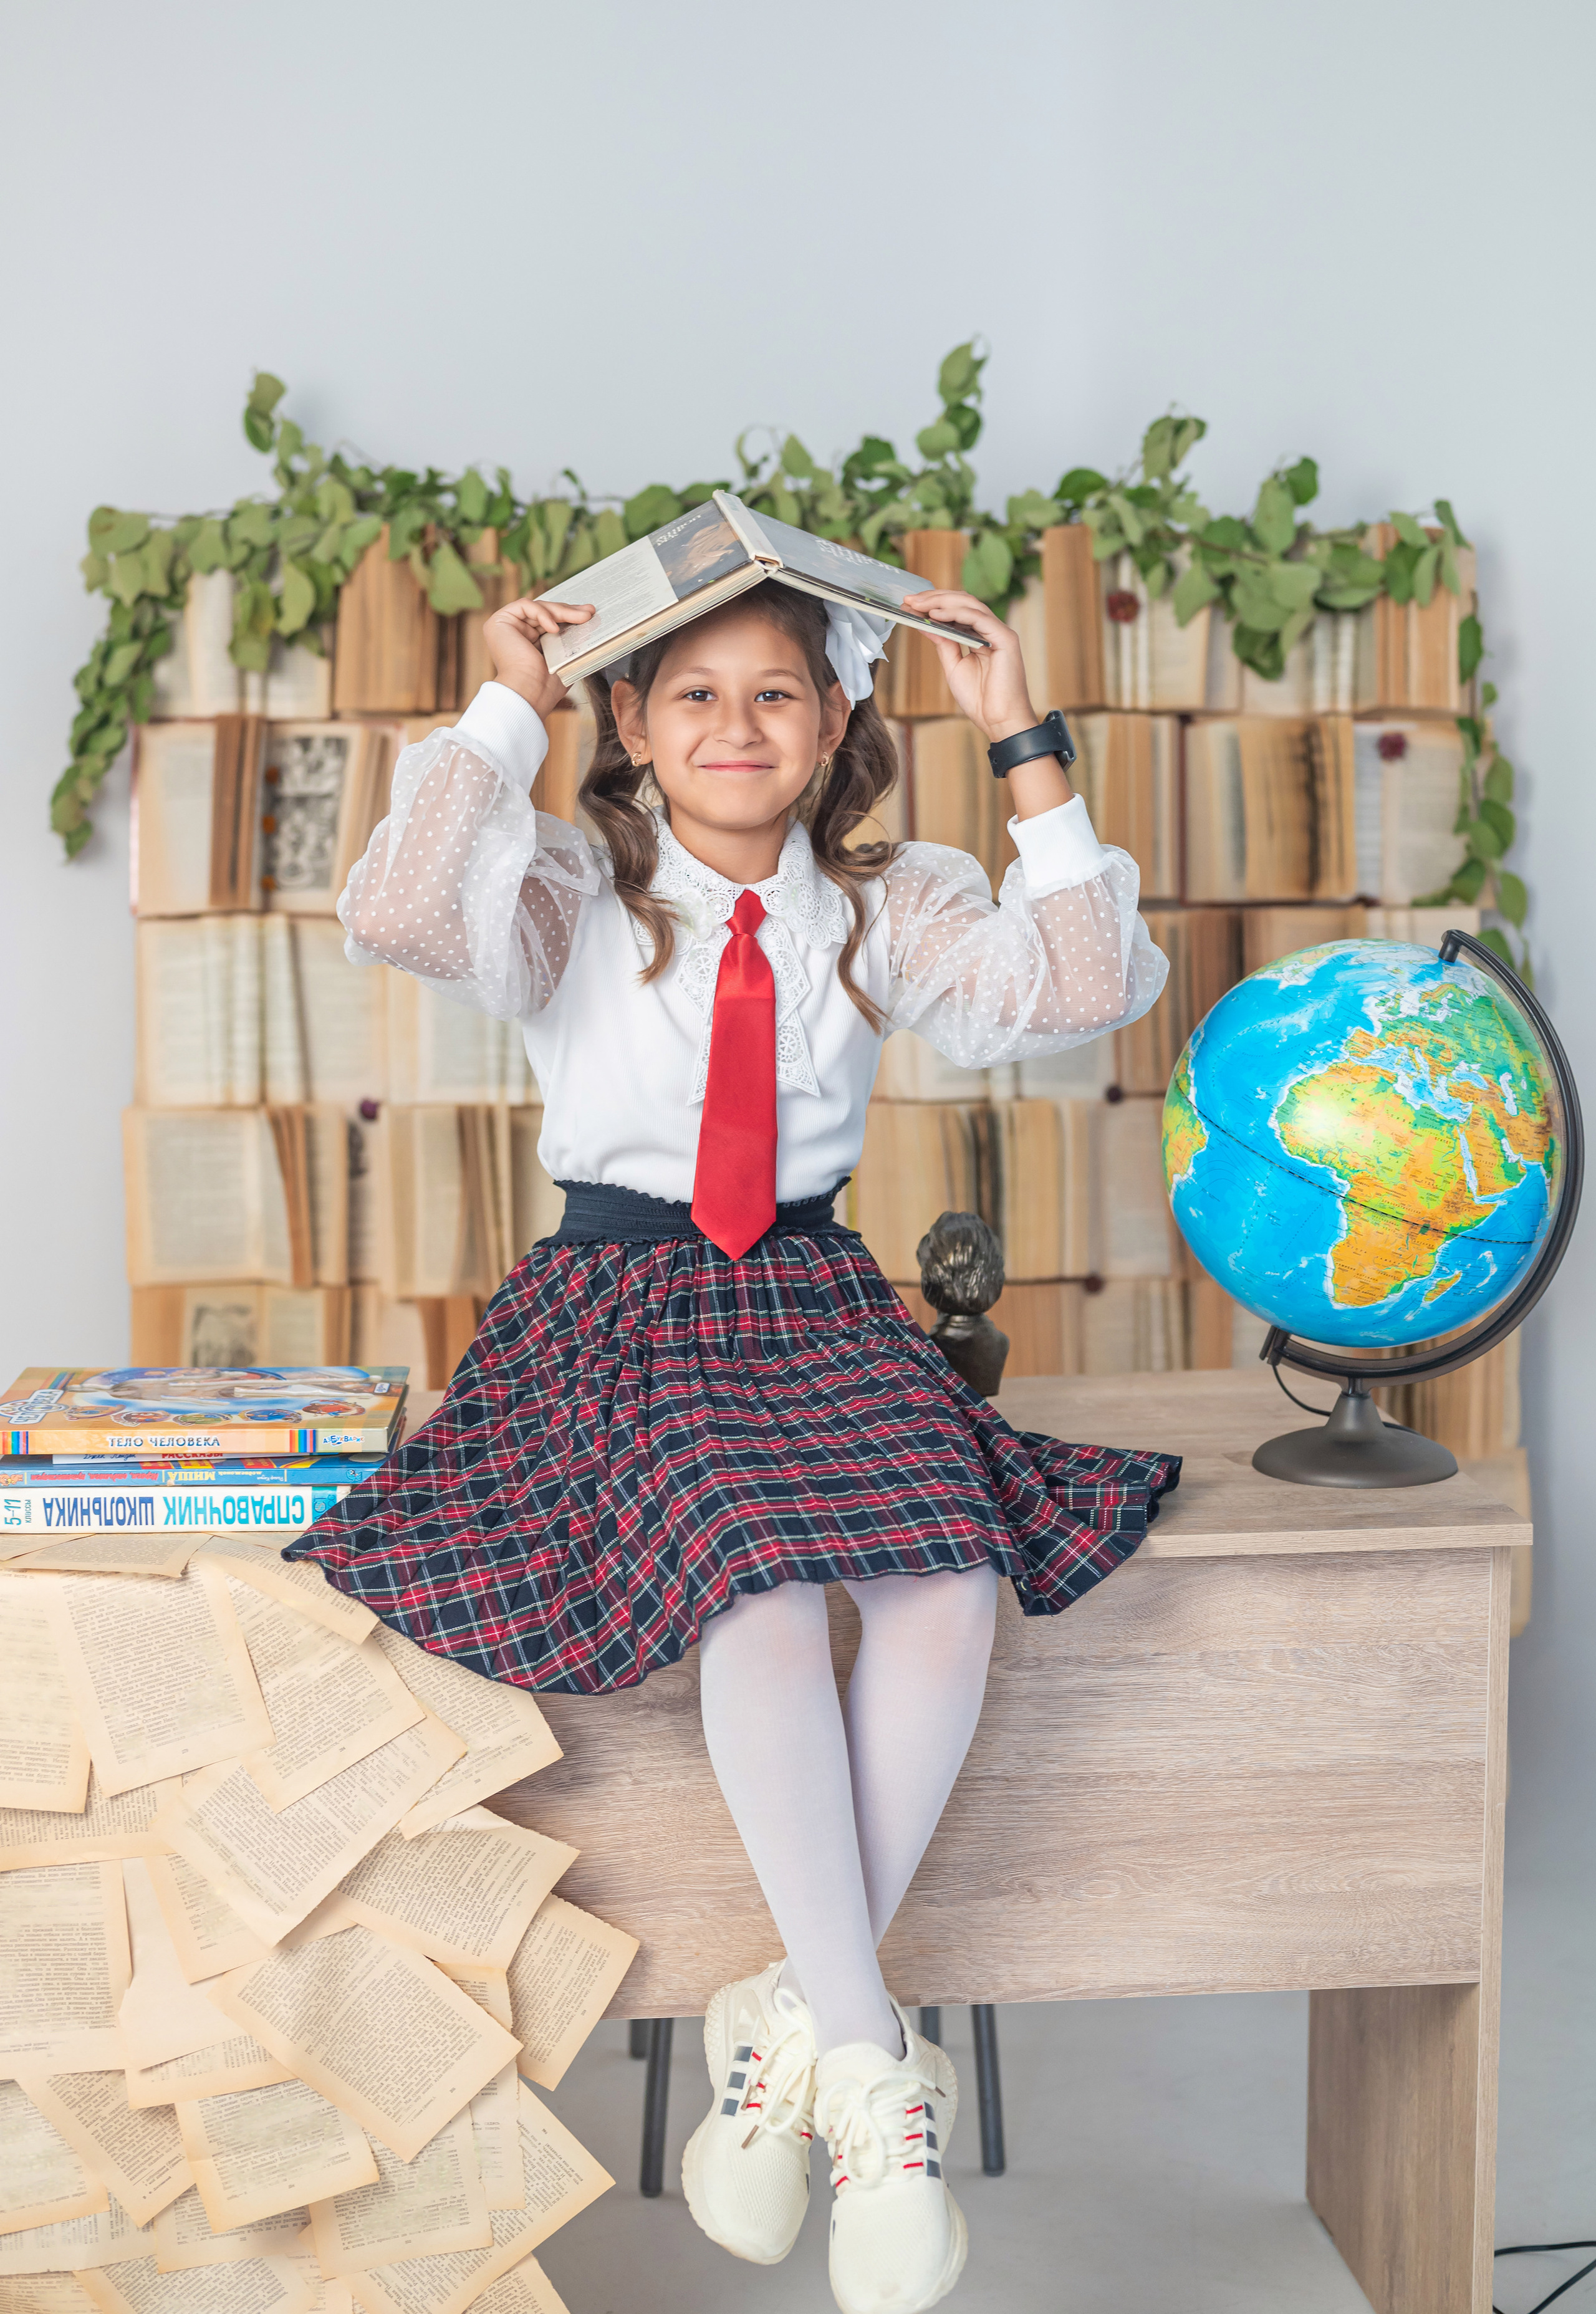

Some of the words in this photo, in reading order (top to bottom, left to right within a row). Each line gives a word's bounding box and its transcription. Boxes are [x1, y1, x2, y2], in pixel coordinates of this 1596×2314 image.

[109, 1436, 142, 1447] ТЕЛО
[149, 1436, 220, 1447] ЧЕЛОВЕКА
[323, 1435, 363, 1446] АЗБУКВАРИК
[168, 1471, 216, 1482] МИША
[43, 1496, 154, 1526] ШКОЛЬНИКА
[163, 1495, 304, 1525] СПРАВОЧНИК
